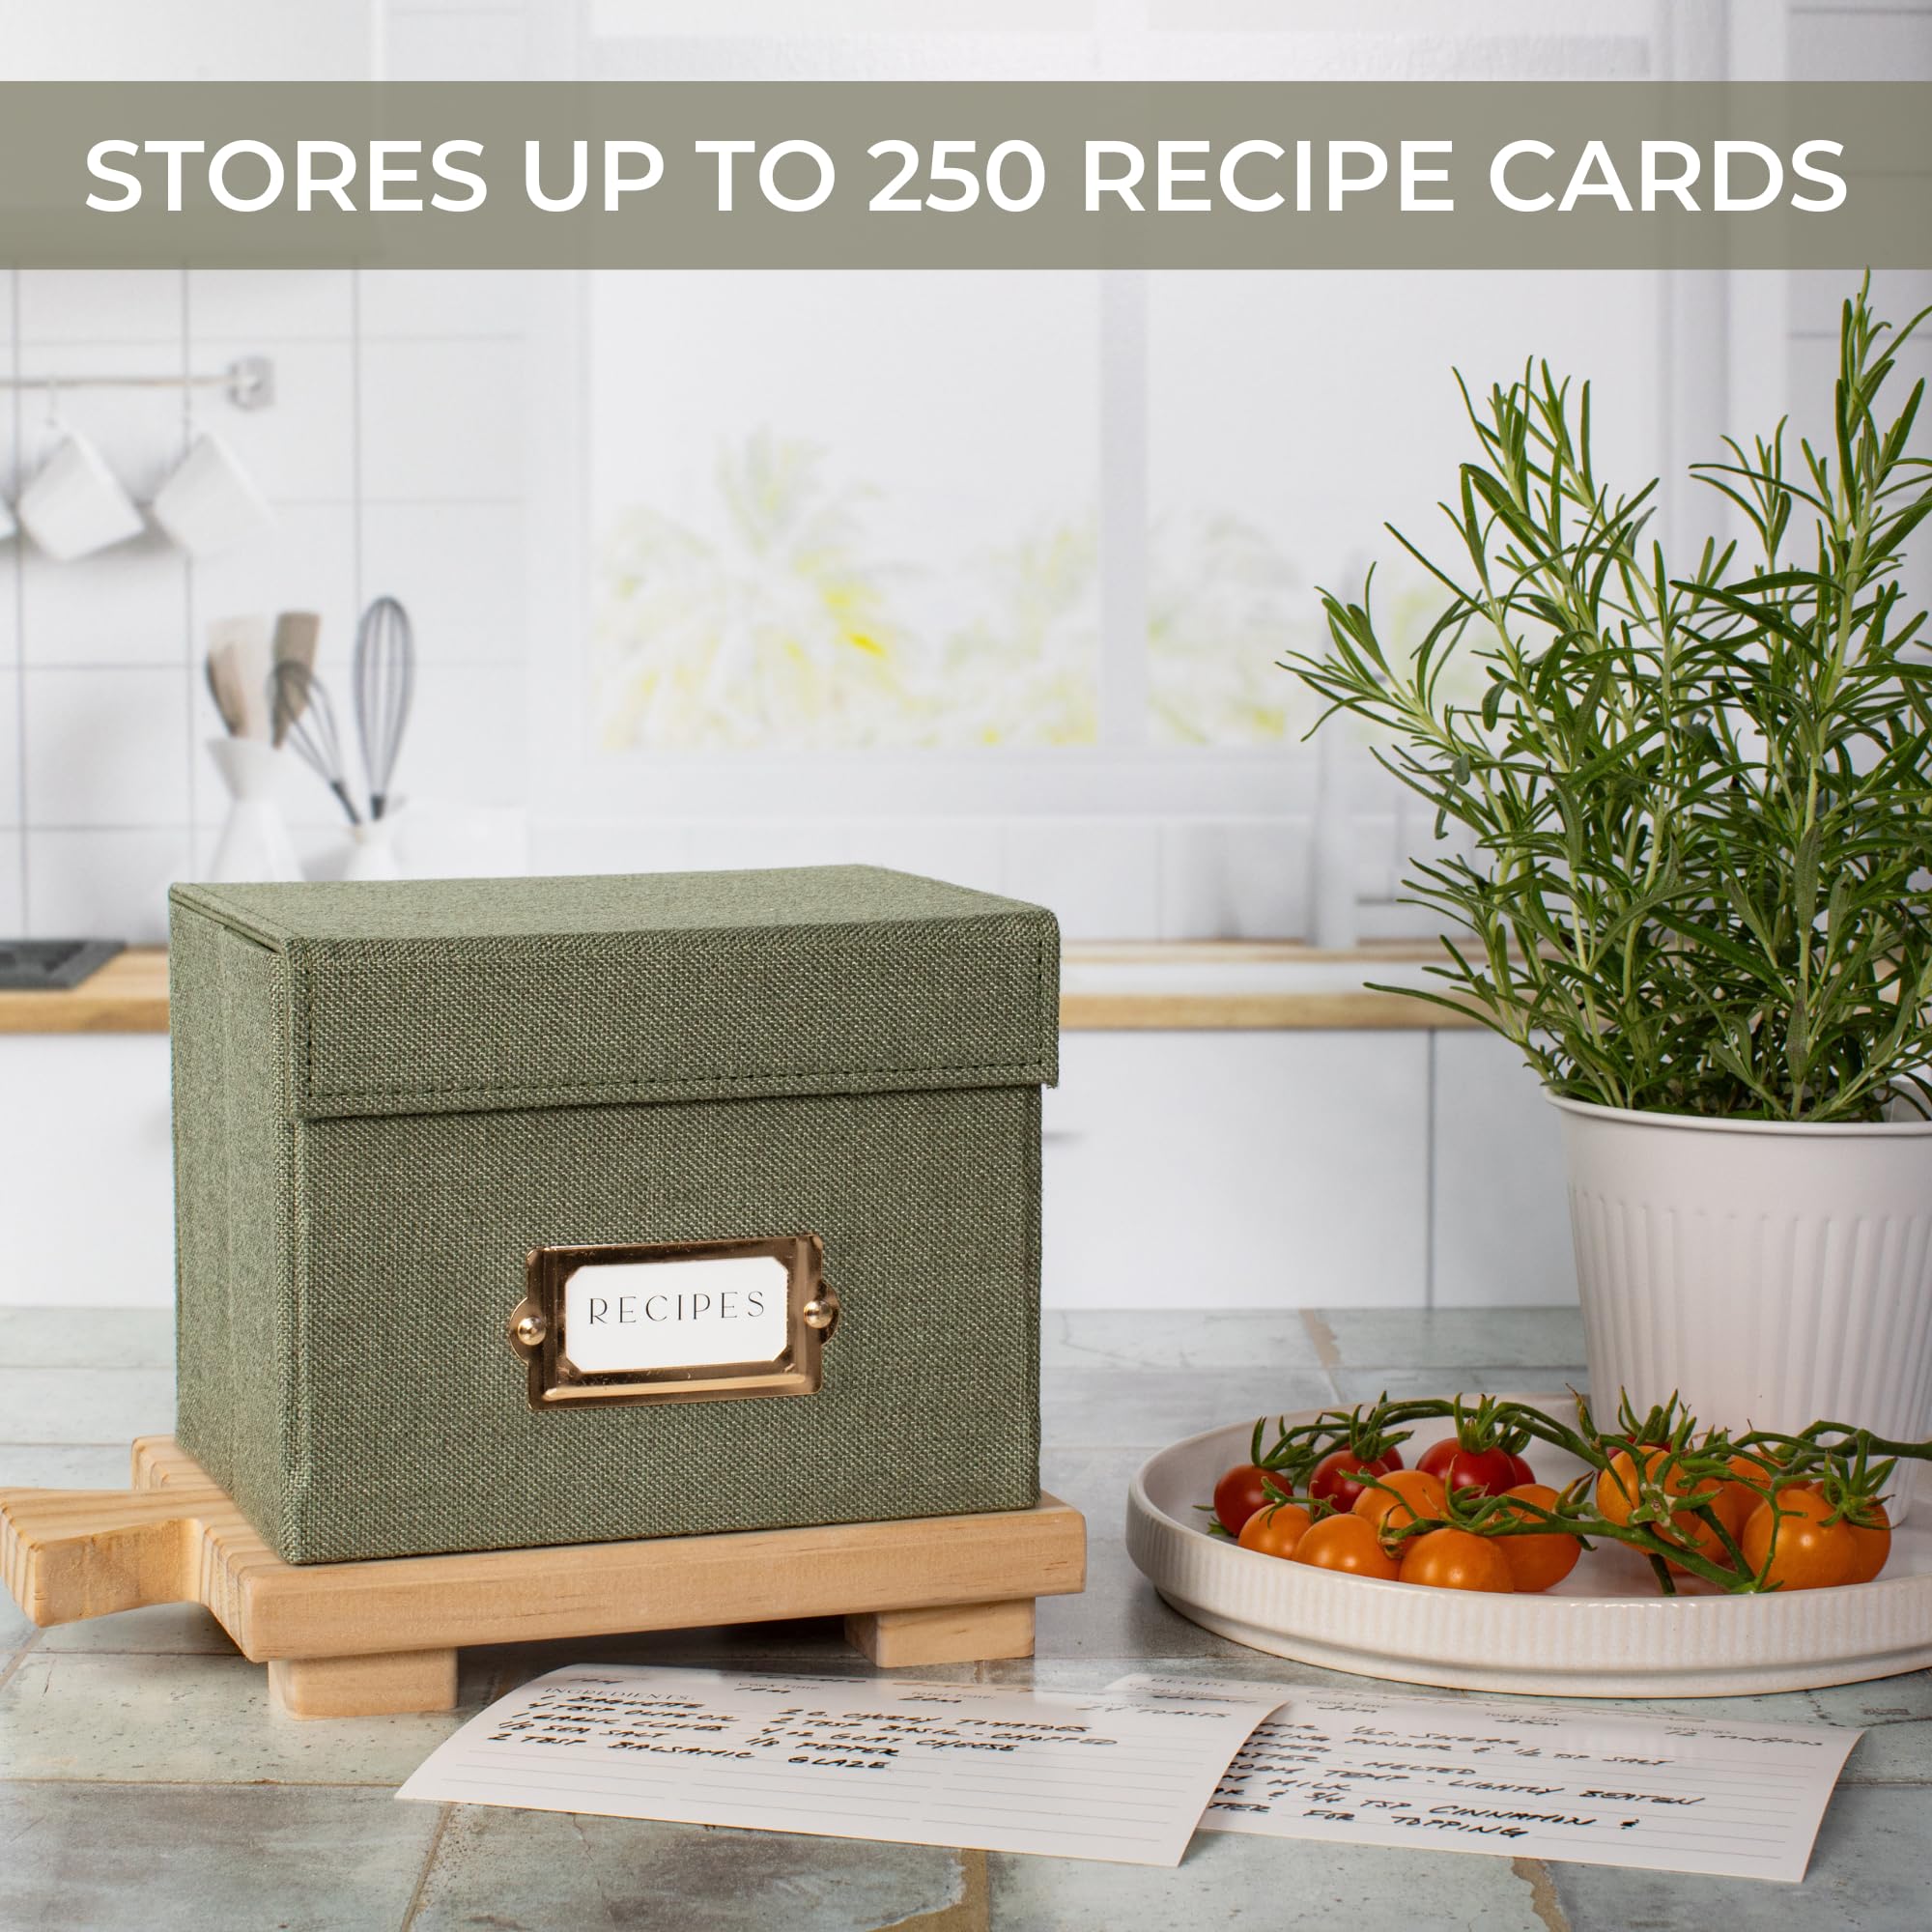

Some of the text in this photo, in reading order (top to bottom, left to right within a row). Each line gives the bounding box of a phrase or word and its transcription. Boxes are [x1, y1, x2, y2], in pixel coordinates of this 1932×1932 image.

[588, 1290, 765, 1325] RECIPES
[598, 1729, 671, 1738] SALT
[801, 1719, 864, 1728] TBSP
[878, 1725, 961, 1736] BASIL
[990, 1733, 1119, 1745] CHOPPED
[520, 1735, 587, 1746] TBSP
[607, 1741, 755, 1758] BALSAMIC
[795, 1742, 900, 1757] PEPPER
[830, 1733, 905, 1744] GOAT
[916, 1740, 1020, 1751] CHEESE
[787, 1756, 891, 1769] GLAZE
[1362, 1761, 1477, 1775] MELTED
[1266, 1779, 1352, 1791] MILK
[1323, 1770, 1410, 1780] TEMP
[1448, 1779, 1566, 1796] LIGHTLY
[1578, 1790, 1706, 1805] BEATEN
[1359, 1800, 1412, 1809] TSP
[1302, 1809, 1355, 1821] FOR
[1390, 1815, 1529, 1838] TOPPING
